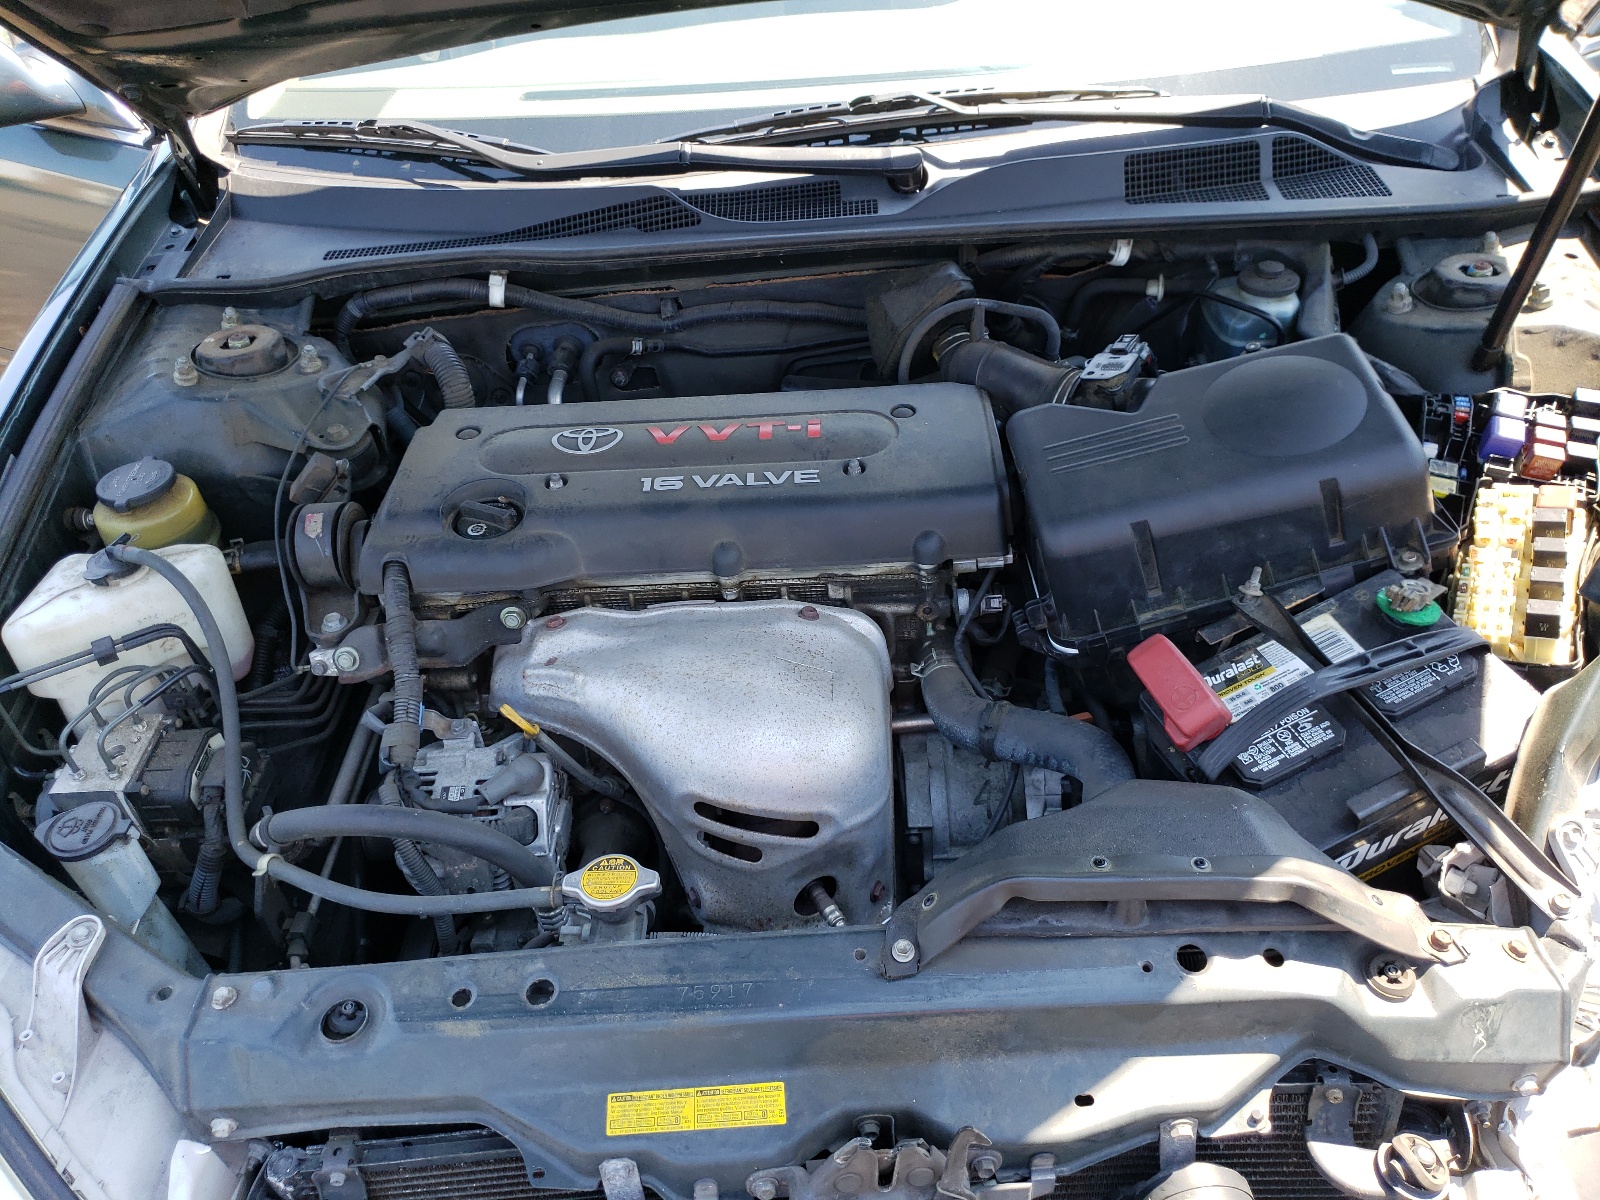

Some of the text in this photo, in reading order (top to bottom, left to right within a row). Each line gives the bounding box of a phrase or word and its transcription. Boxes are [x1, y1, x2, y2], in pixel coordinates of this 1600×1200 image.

[646, 419, 821, 445] VVT-i
[640, 469, 820, 492] 16 VALVE
[1280, 707, 1310, 726] POISON
[1335, 769, 1511, 871] Duralt
[676, 982, 753, 1001] 75917
